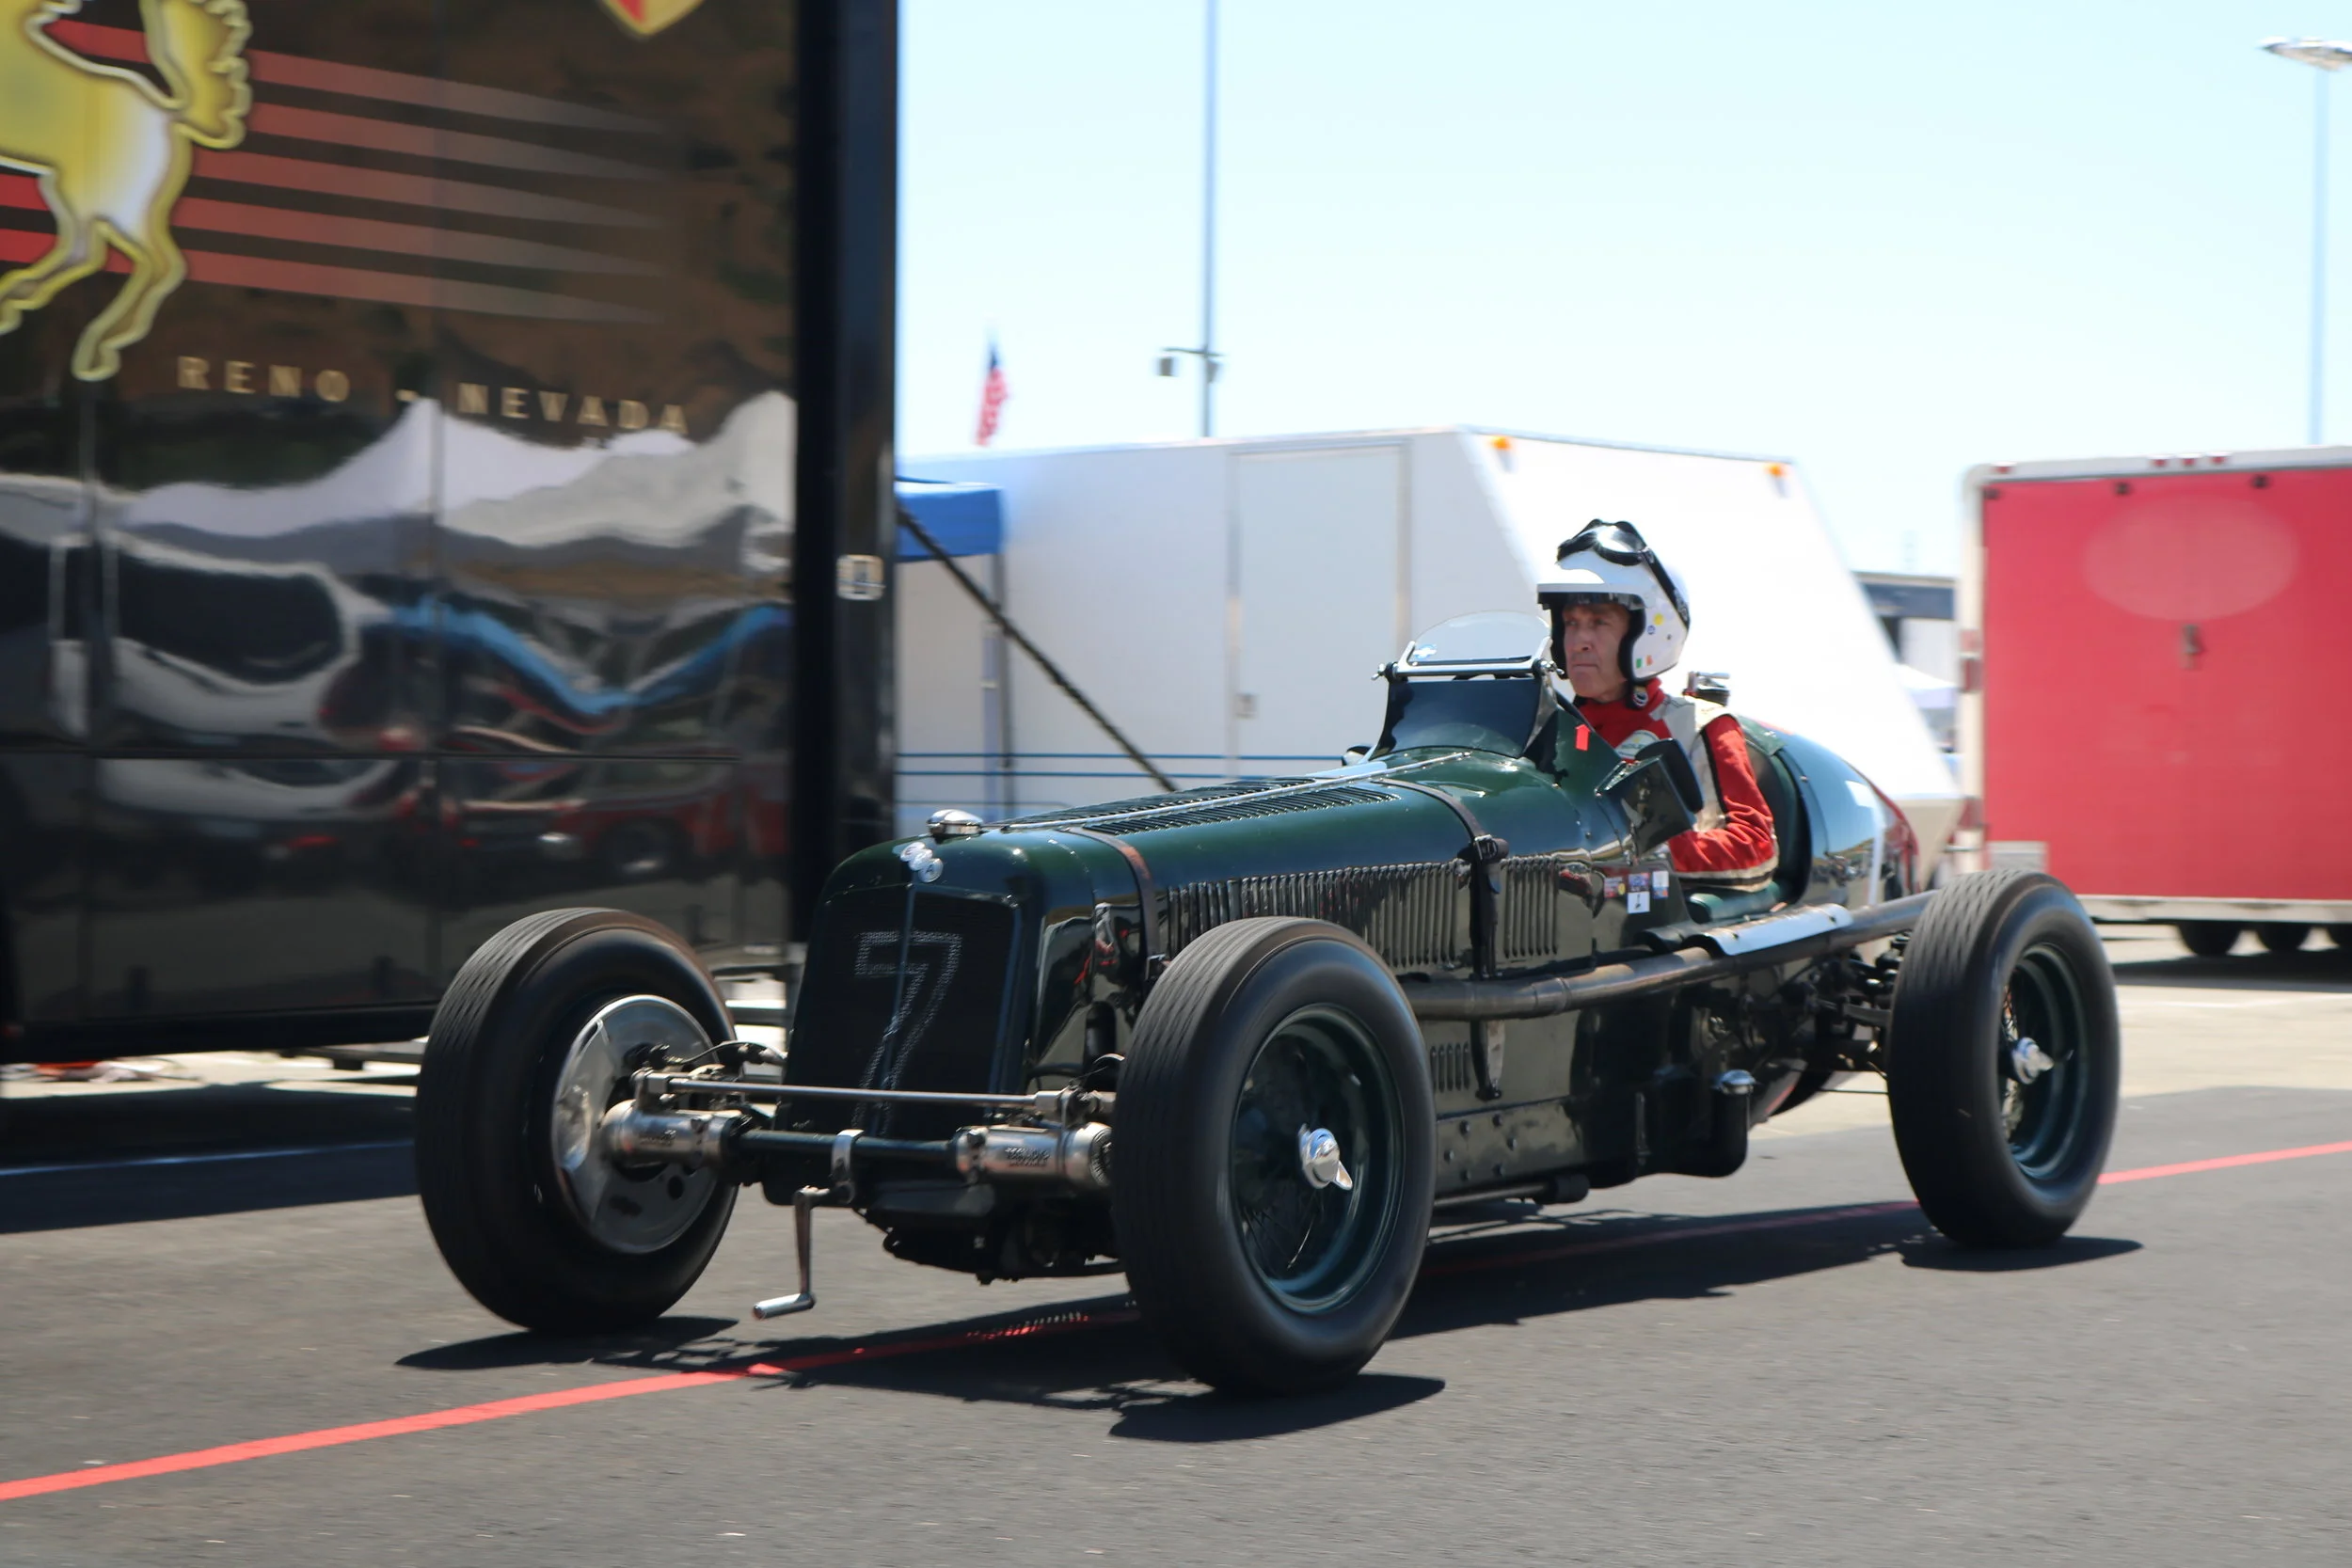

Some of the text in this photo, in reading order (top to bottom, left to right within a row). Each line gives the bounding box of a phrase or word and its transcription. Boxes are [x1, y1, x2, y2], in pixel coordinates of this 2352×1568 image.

[177, 356, 351, 403] RENO
[457, 382, 690, 436] NEVADA
[853, 930, 963, 1135] 7
